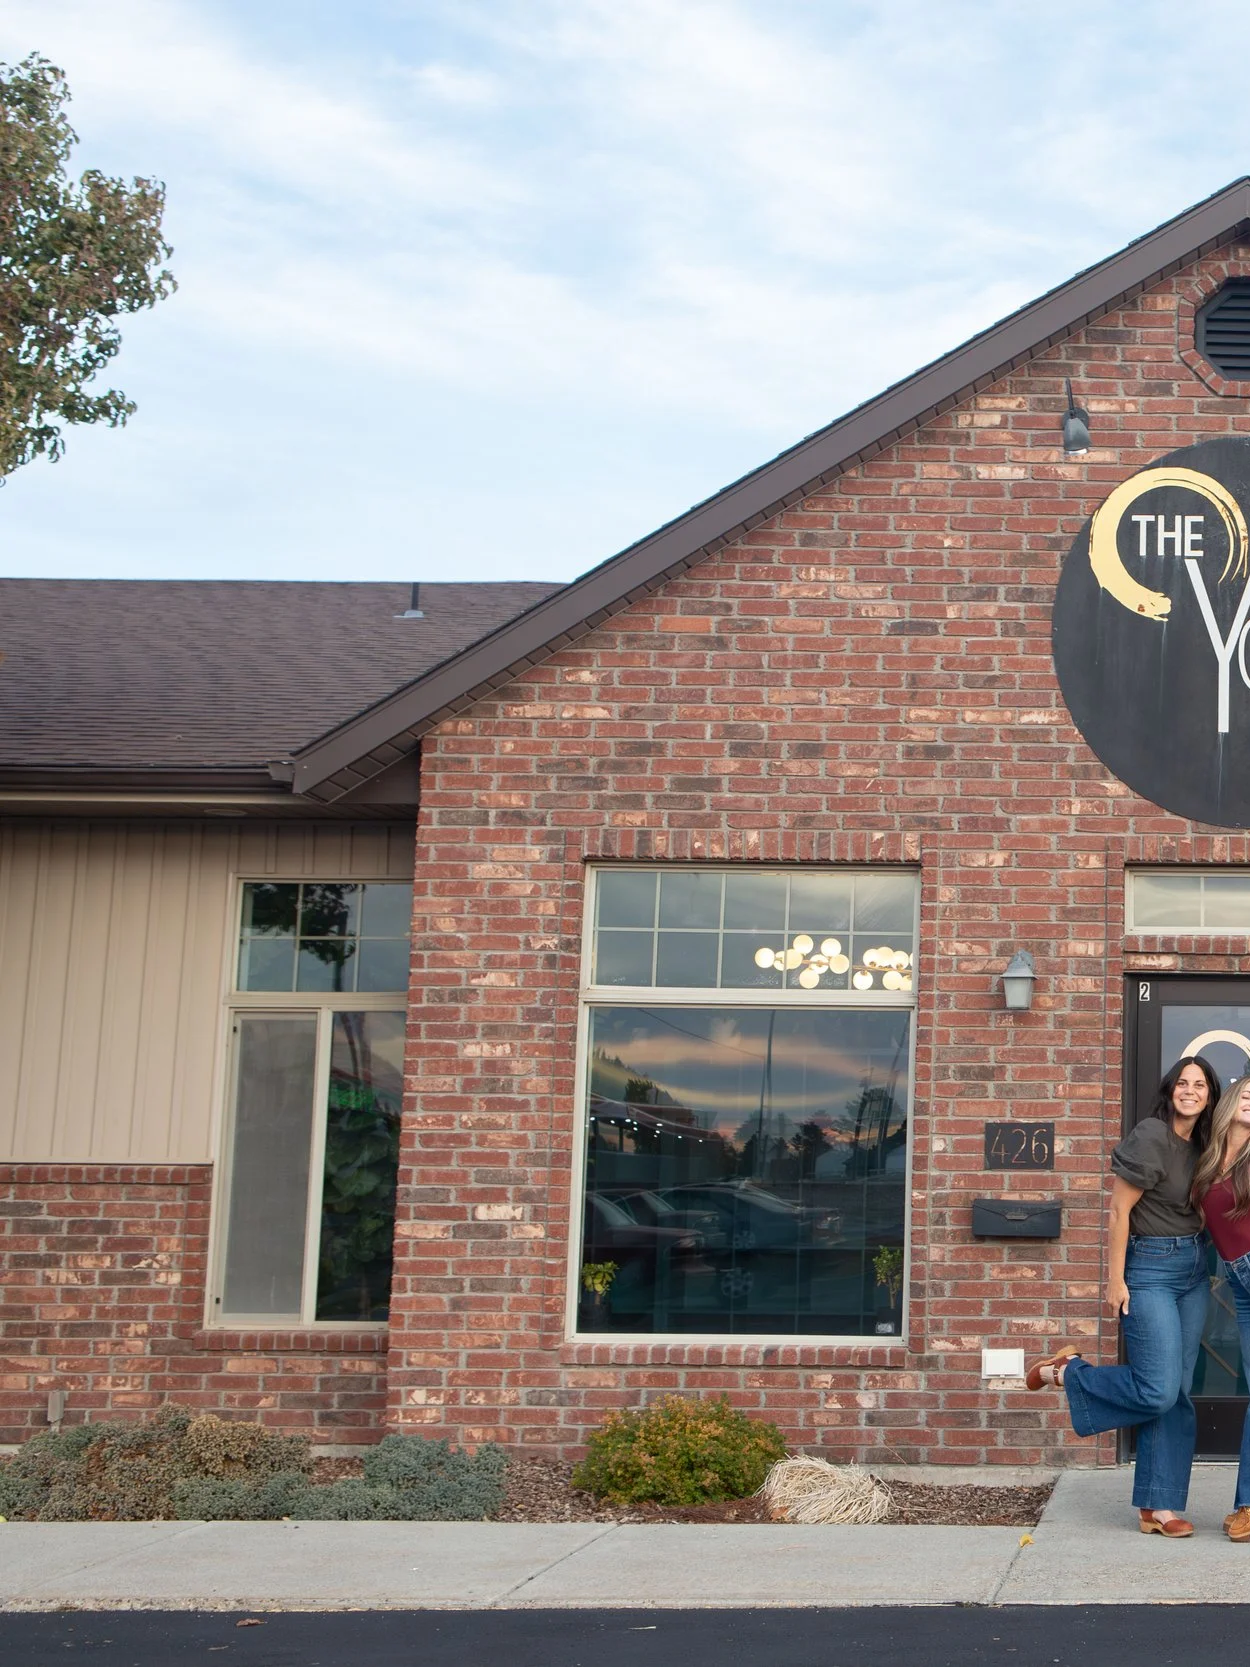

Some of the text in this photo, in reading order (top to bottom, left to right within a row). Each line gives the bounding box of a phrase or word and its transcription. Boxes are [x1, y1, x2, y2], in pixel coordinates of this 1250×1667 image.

[1131, 515, 1204, 556] THE
[1141, 983, 1148, 1000] 2
[991, 1128, 1049, 1164] 426
